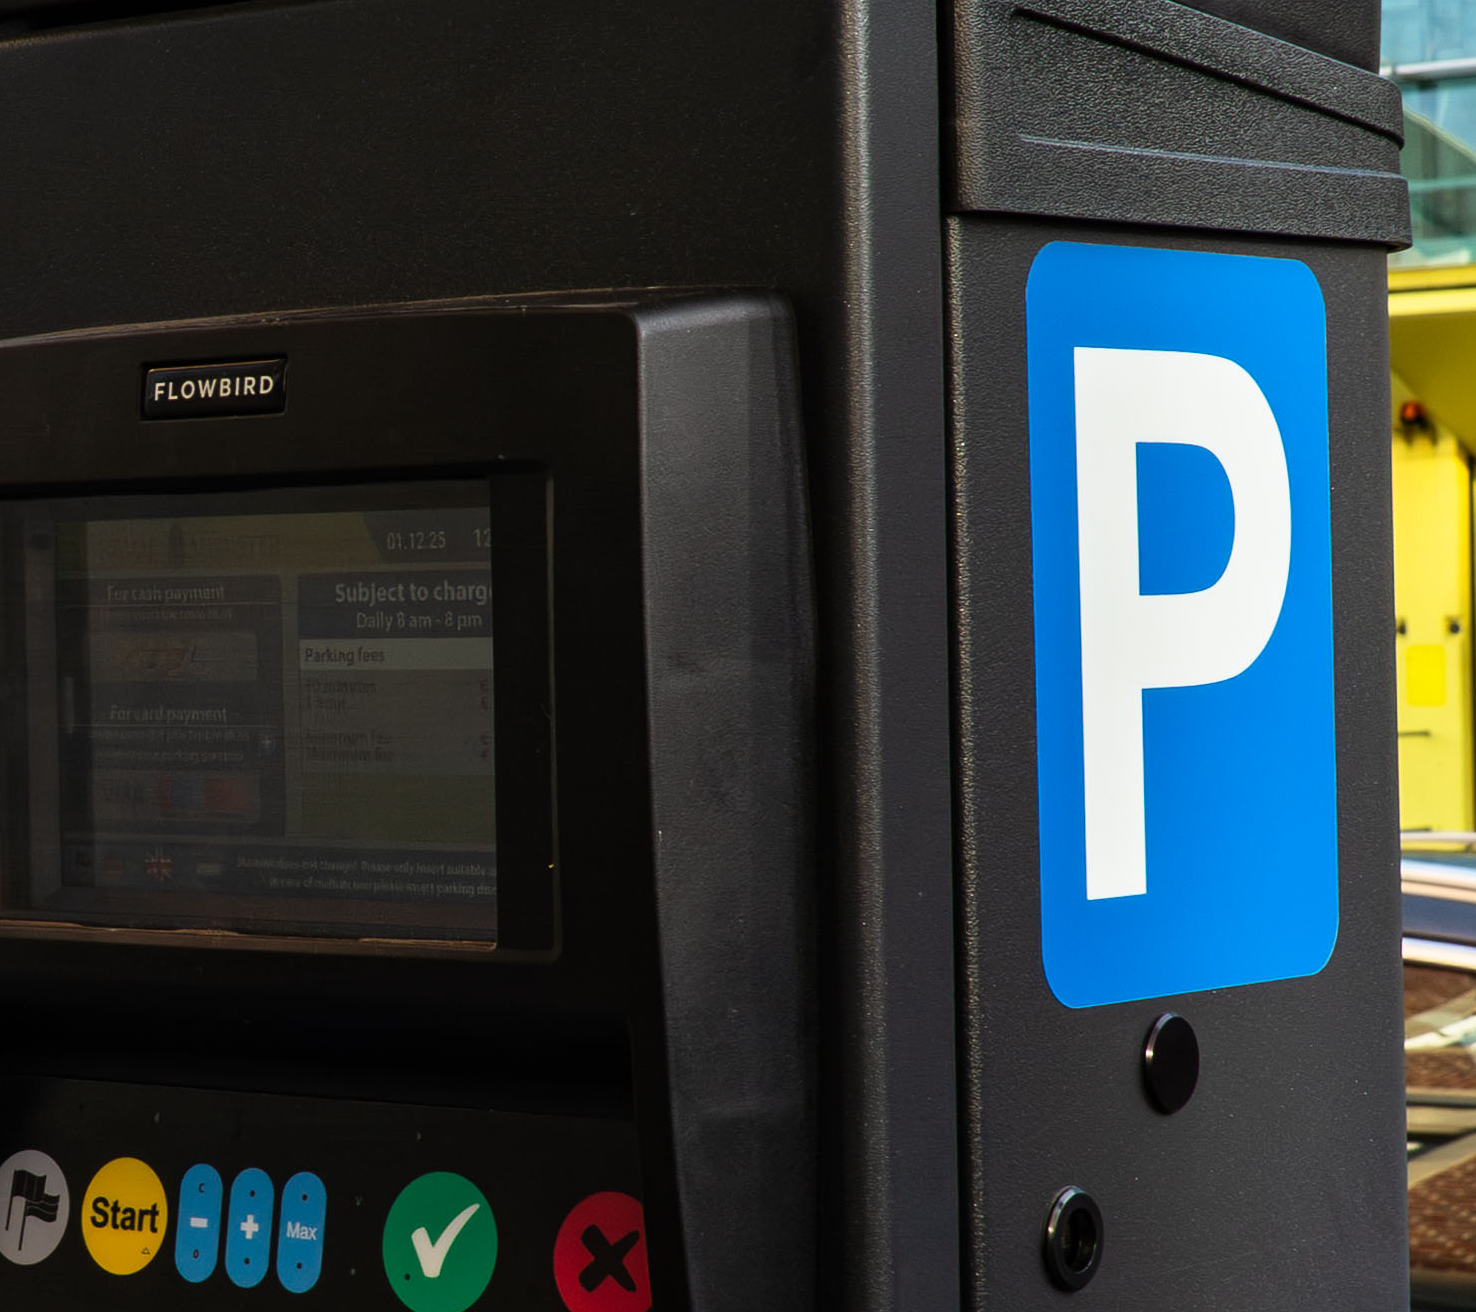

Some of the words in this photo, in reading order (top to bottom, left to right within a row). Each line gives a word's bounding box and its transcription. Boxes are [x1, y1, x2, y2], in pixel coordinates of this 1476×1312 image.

[154, 375, 274, 401] FLOWBIRD
[132, 584, 161, 601] cash
[164, 585, 224, 605] payment
[335, 582, 405, 607] Subject
[410, 583, 428, 602] to
[357, 611, 393, 632] Daily
[409, 615, 432, 628] am
[458, 614, 483, 631] pm
[1072, 346, 1292, 901] P
[305, 647, 354, 665] Parking
[358, 645, 386, 662] fees
[166, 707, 227, 725] payment
[90, 1195, 160, 1234] Start
[286, 1220, 318, 1241] Max
